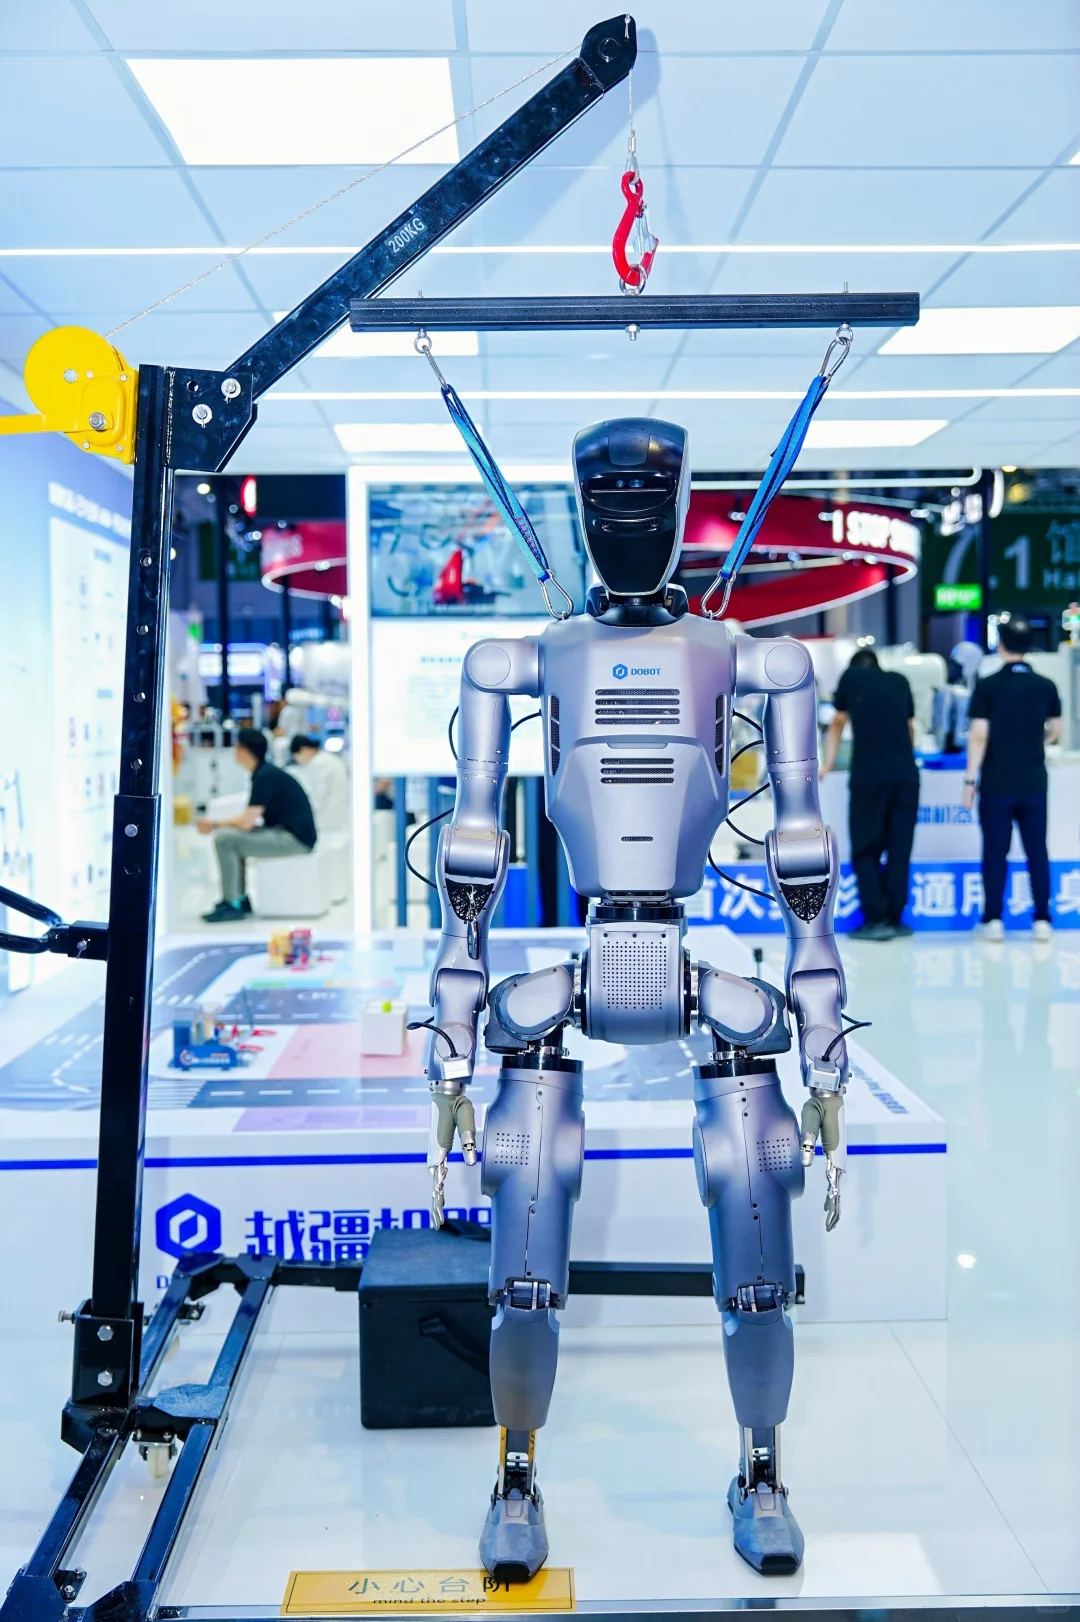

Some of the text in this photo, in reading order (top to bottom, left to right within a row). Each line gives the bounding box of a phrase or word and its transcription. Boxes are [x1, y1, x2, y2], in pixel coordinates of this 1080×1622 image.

[388, 217, 426, 254] 200KG
[631, 668, 662, 676] DOBOT
[451, 1597, 486, 1605] step
